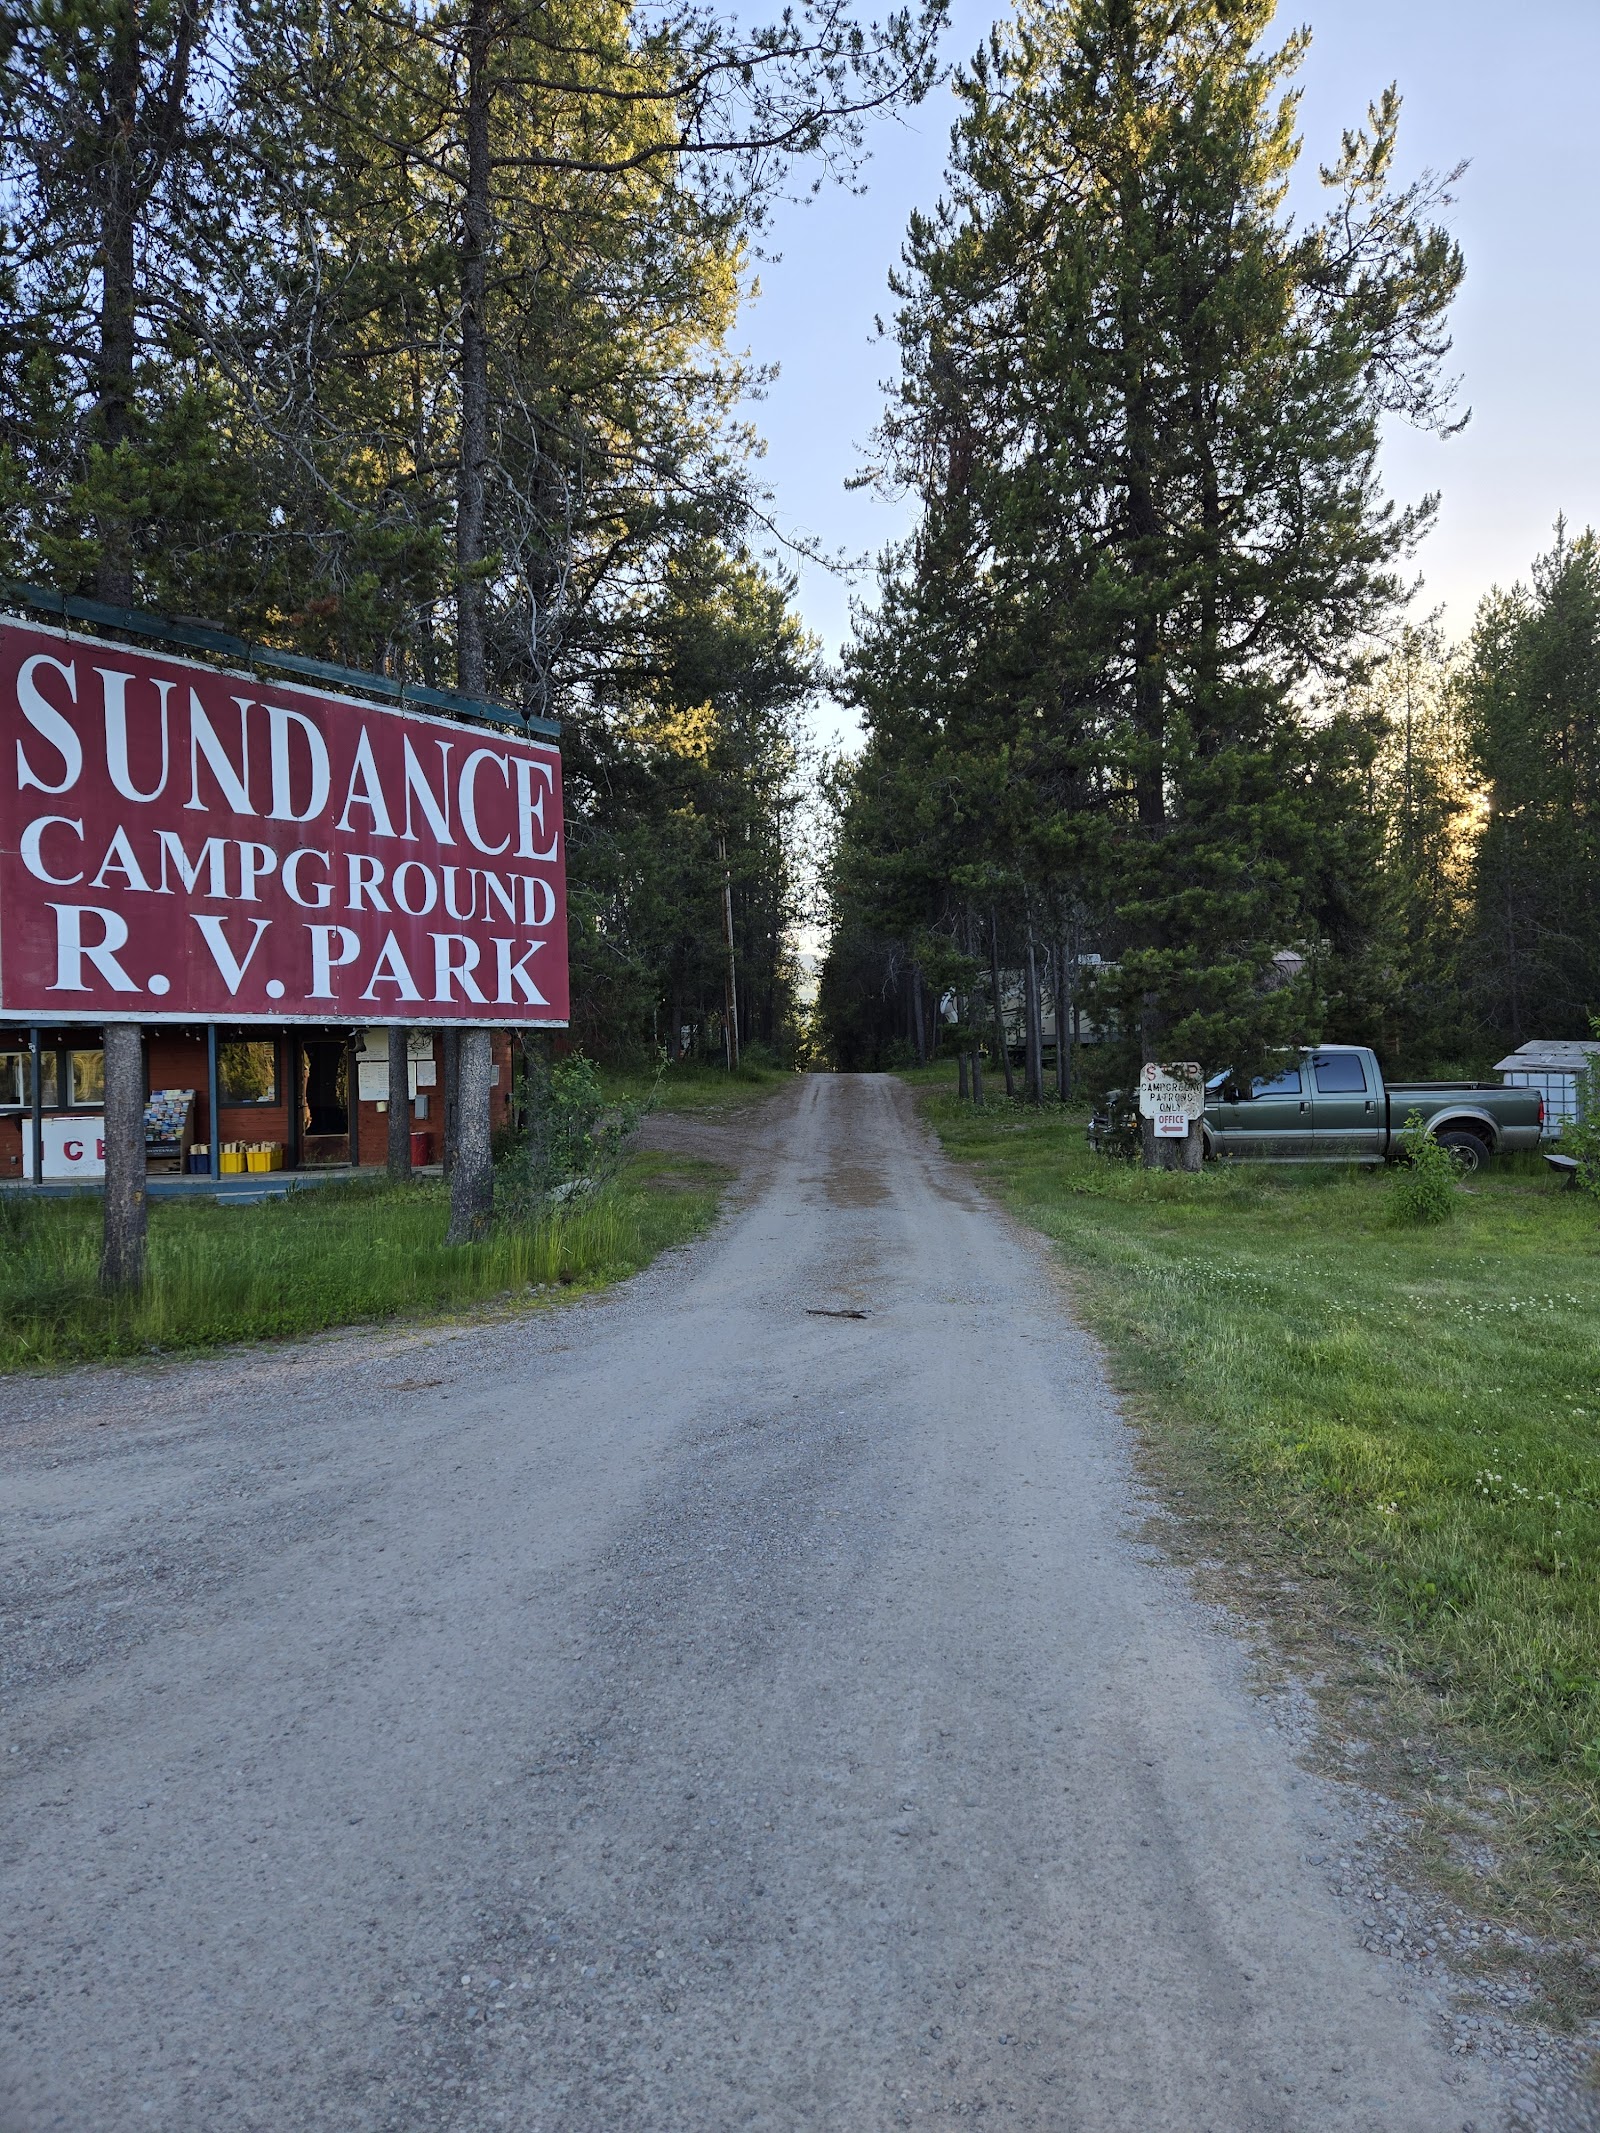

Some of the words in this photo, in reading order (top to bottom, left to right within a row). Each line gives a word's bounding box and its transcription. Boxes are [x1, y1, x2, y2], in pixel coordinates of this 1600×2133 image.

[16, 654, 560, 863] SUNDANCE
[19, 815, 557, 926] CAMPGROUND
[44, 902, 171, 996] R.
[190, 914, 286, 999] V.
[302, 923, 551, 1006] PARK
[1150, 1093, 1193, 1102] PATRONS
[1159, 1103, 1181, 1112] ONLY
[1159, 1115, 1184, 1124] OFFICE
